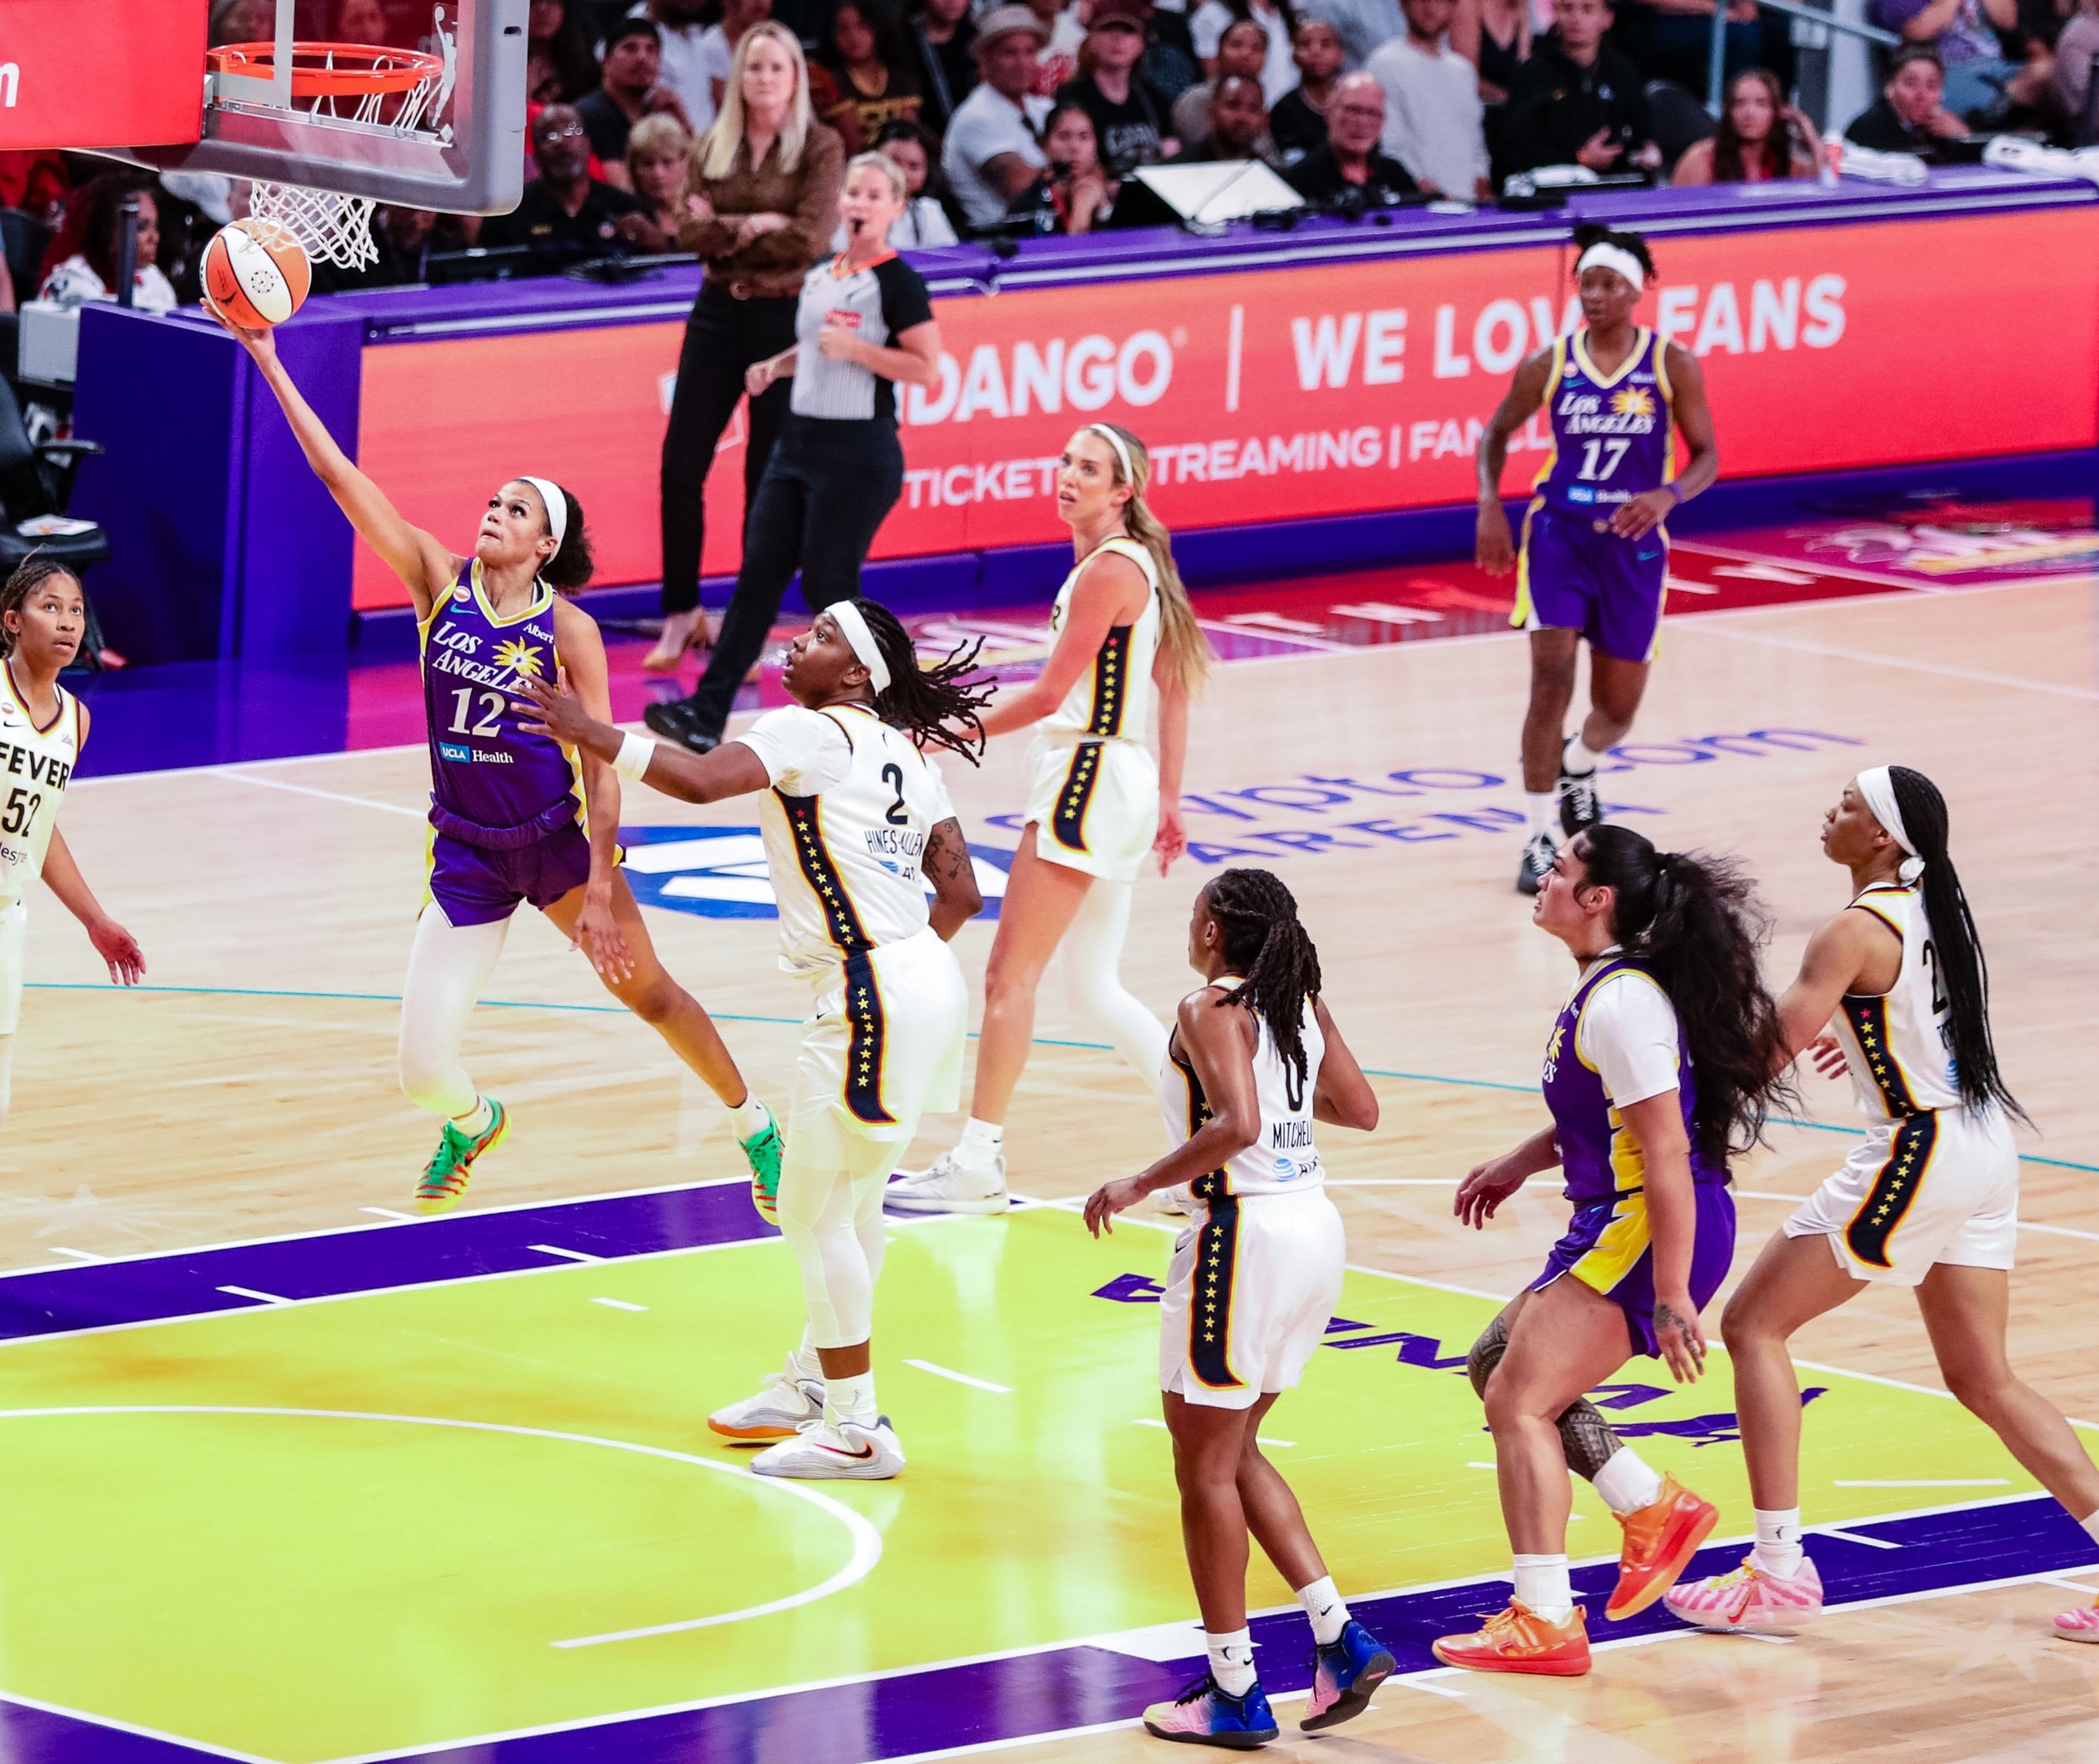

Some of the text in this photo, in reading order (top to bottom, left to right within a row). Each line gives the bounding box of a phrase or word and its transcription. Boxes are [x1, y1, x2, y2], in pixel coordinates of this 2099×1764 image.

[1291, 275, 1846, 390] WE LOV FANS
[895, 331, 1172, 426] DANGO
[1557, 391, 1602, 416] LOS
[1564, 411, 1657, 434] ANGELES
[903, 456, 1061, 509] TICKET
[1149, 425, 1382, 485] TREAMING
[1576, 437, 1631, 481] 17
[432, 620, 483, 654] LOS
[523, 622, 554, 644] Albert
[448, 687, 506, 738] 12
[442, 746, 514, 764] UCLA Health
[2, 787, 42, 838] 52
[882, 762, 909, 825] 2
